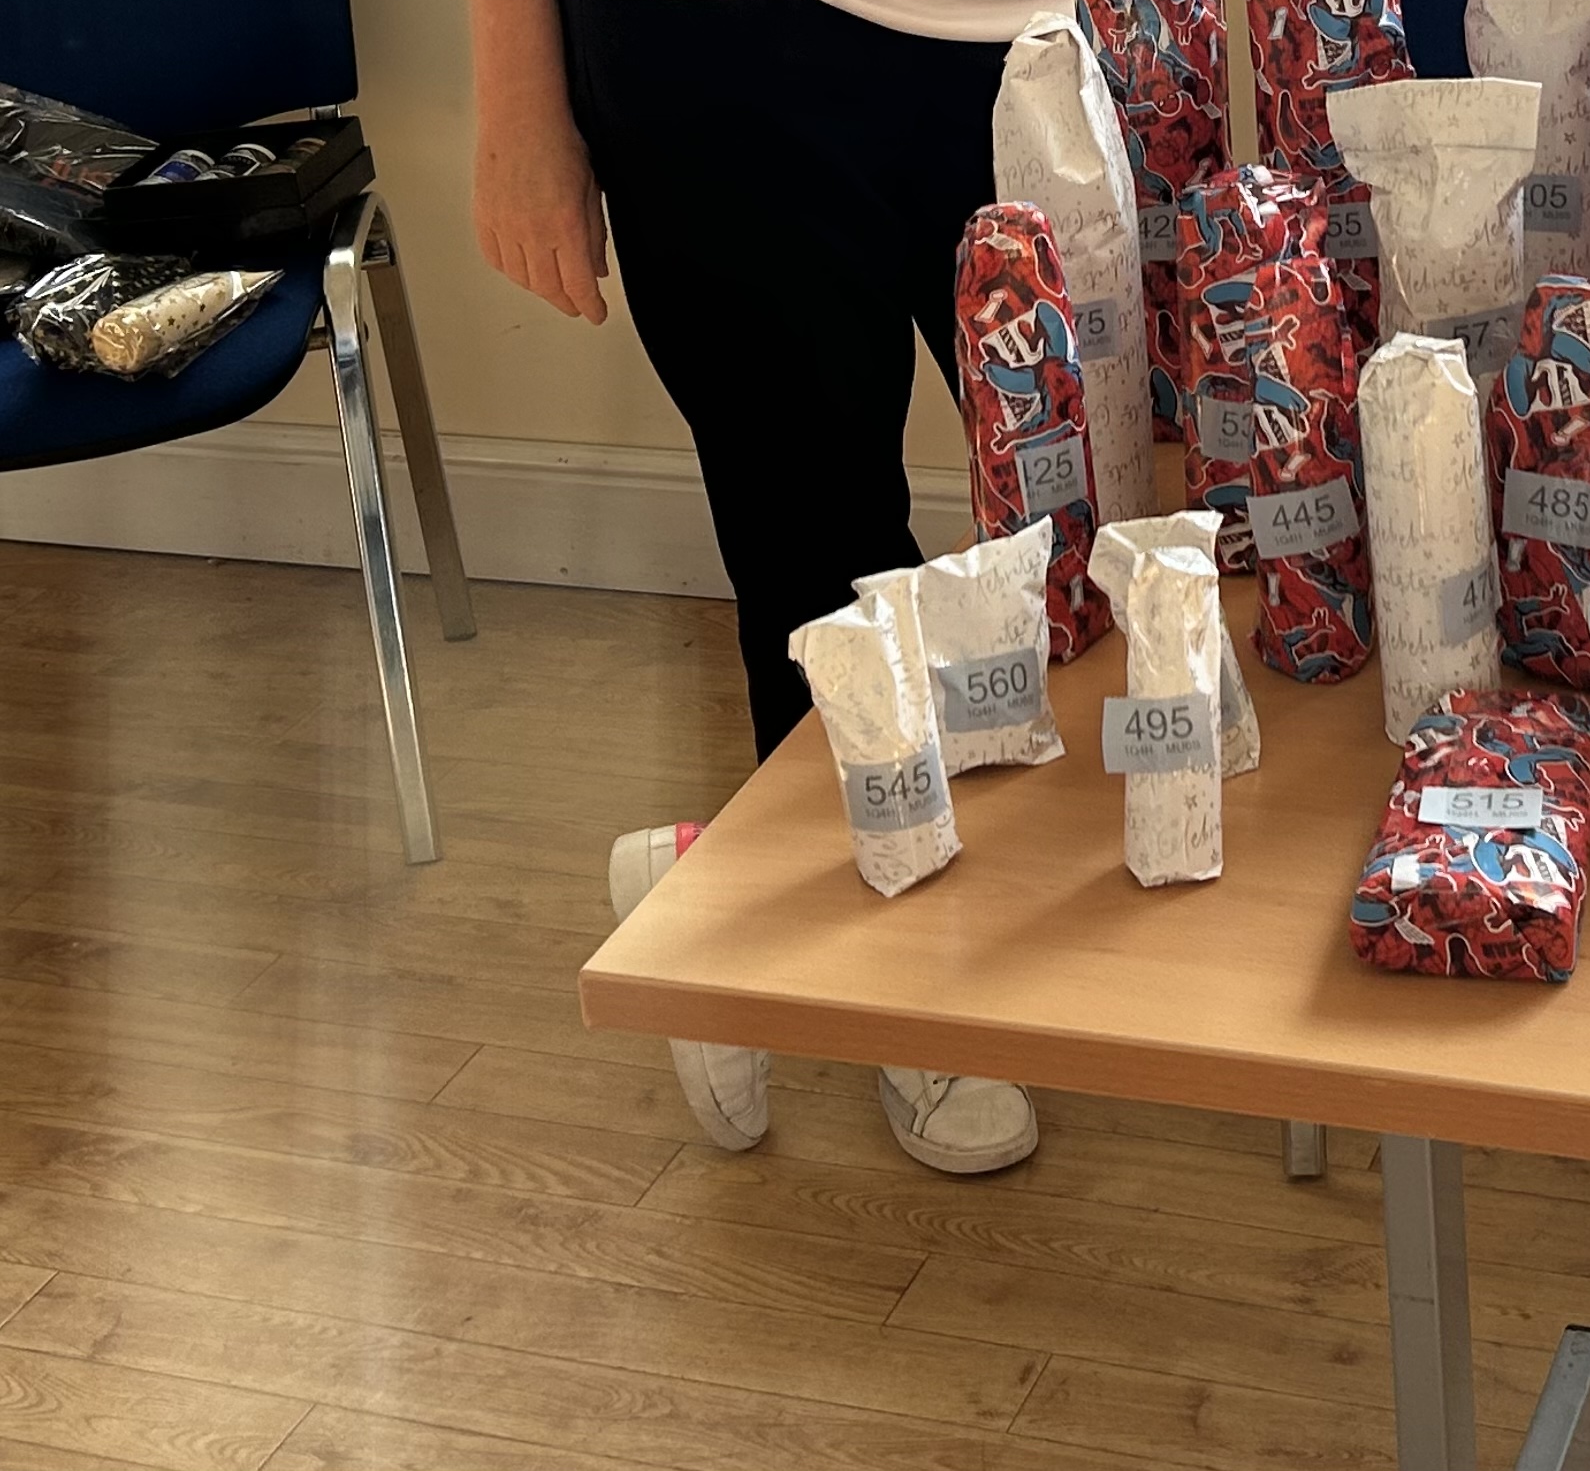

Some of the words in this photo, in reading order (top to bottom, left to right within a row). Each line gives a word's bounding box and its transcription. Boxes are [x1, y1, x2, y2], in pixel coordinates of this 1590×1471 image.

[1271, 493, 1336, 532] 445
[1527, 484, 1590, 522] 485
[967, 661, 1028, 705] 560
[1124, 705, 1194, 742] 495
[865, 759, 932, 806] 545
[1450, 791, 1525, 810] 515
